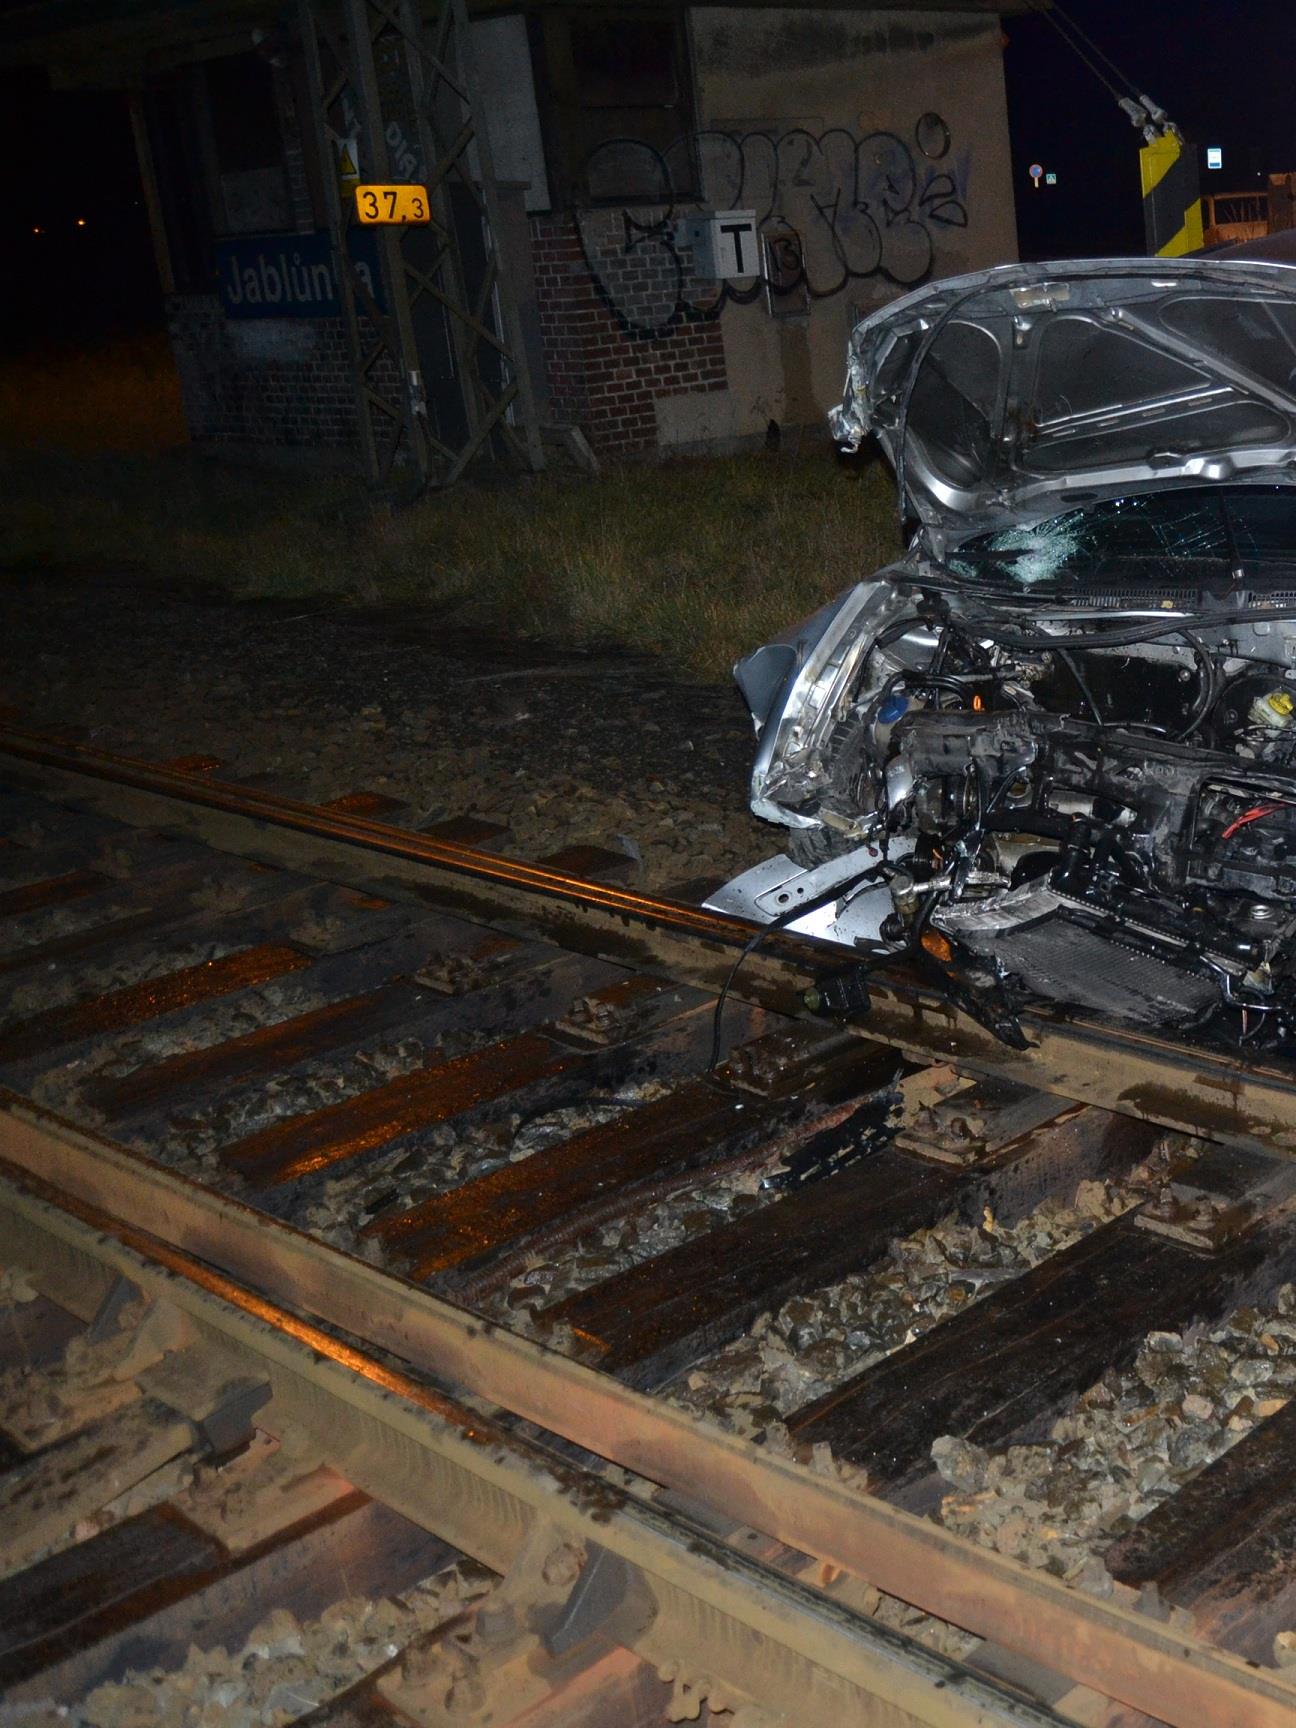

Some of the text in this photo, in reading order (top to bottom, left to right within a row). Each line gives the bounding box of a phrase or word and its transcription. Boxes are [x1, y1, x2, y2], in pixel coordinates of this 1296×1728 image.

[362, 191, 425, 222] 37,3
[720, 223, 753, 274] T
[227, 251, 376, 305] Jablůna
